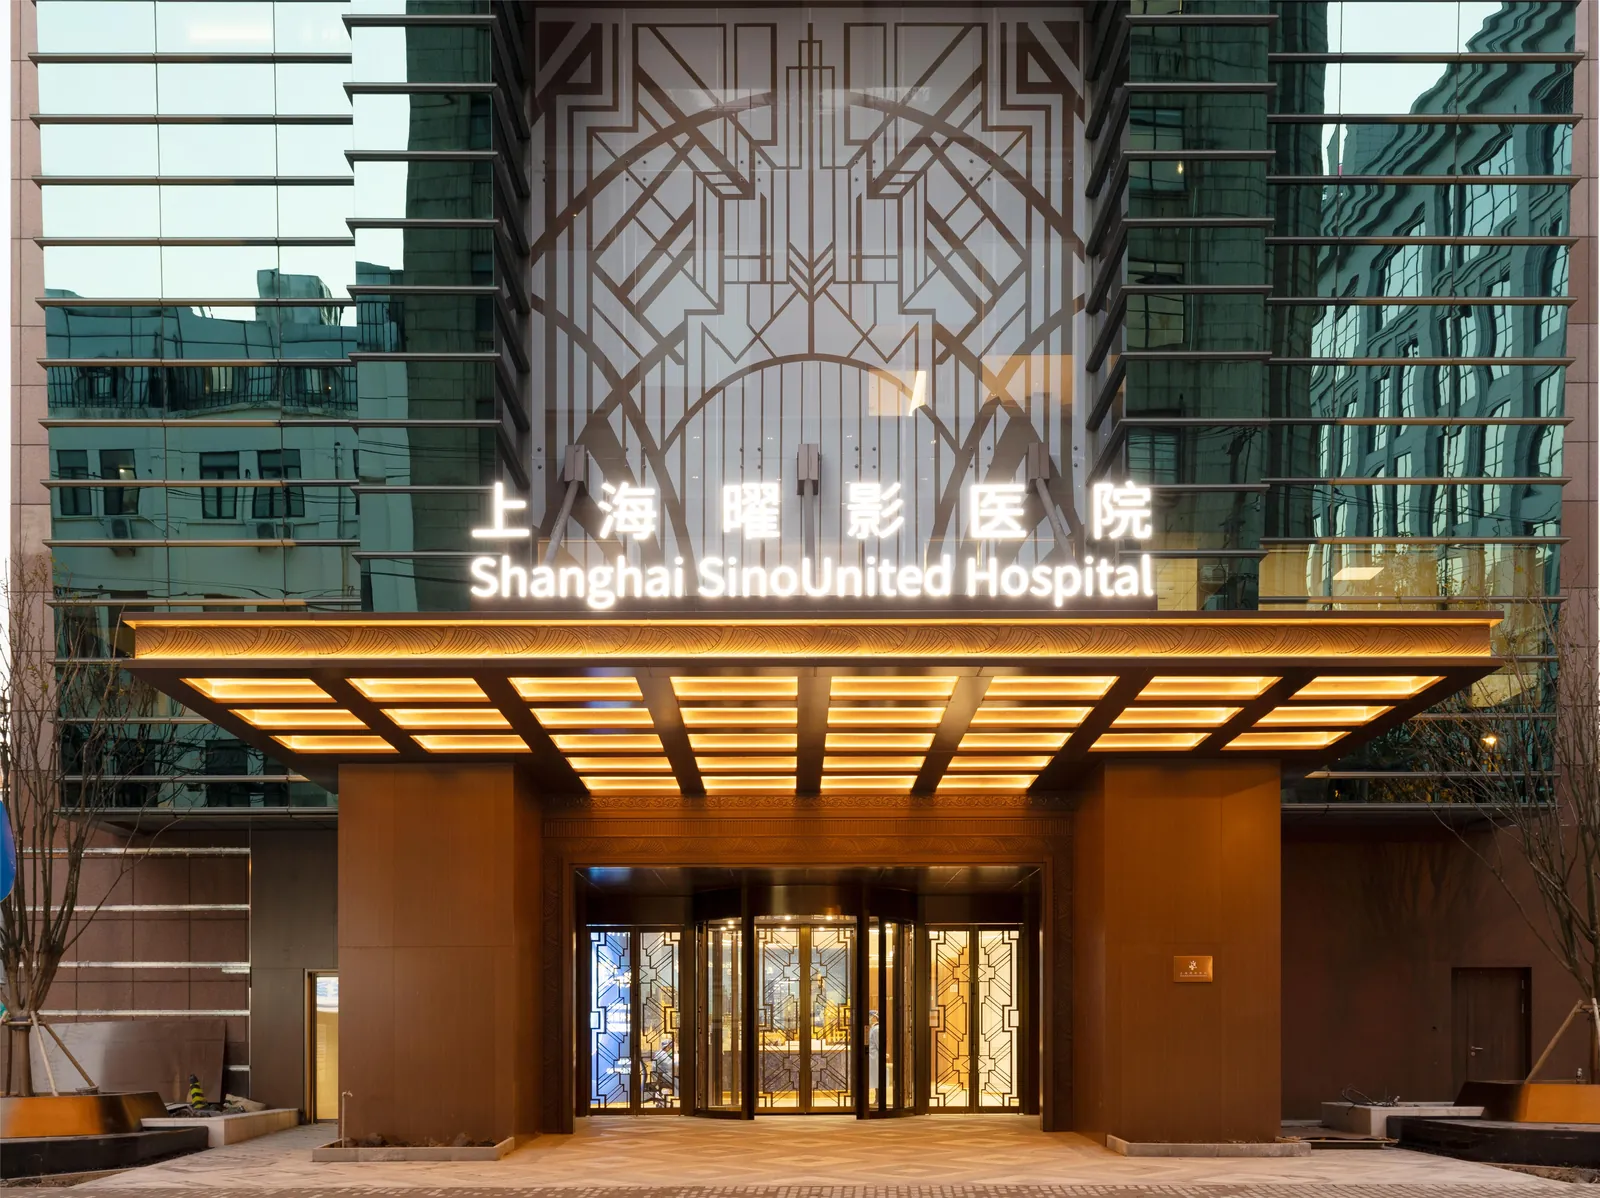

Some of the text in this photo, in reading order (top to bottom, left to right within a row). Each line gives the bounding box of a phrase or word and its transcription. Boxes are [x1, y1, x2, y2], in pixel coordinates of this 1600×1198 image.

[470, 480, 1153, 540] 上海曜影医院
[470, 554, 1154, 610] Shanghai SinoUnited Hospital
